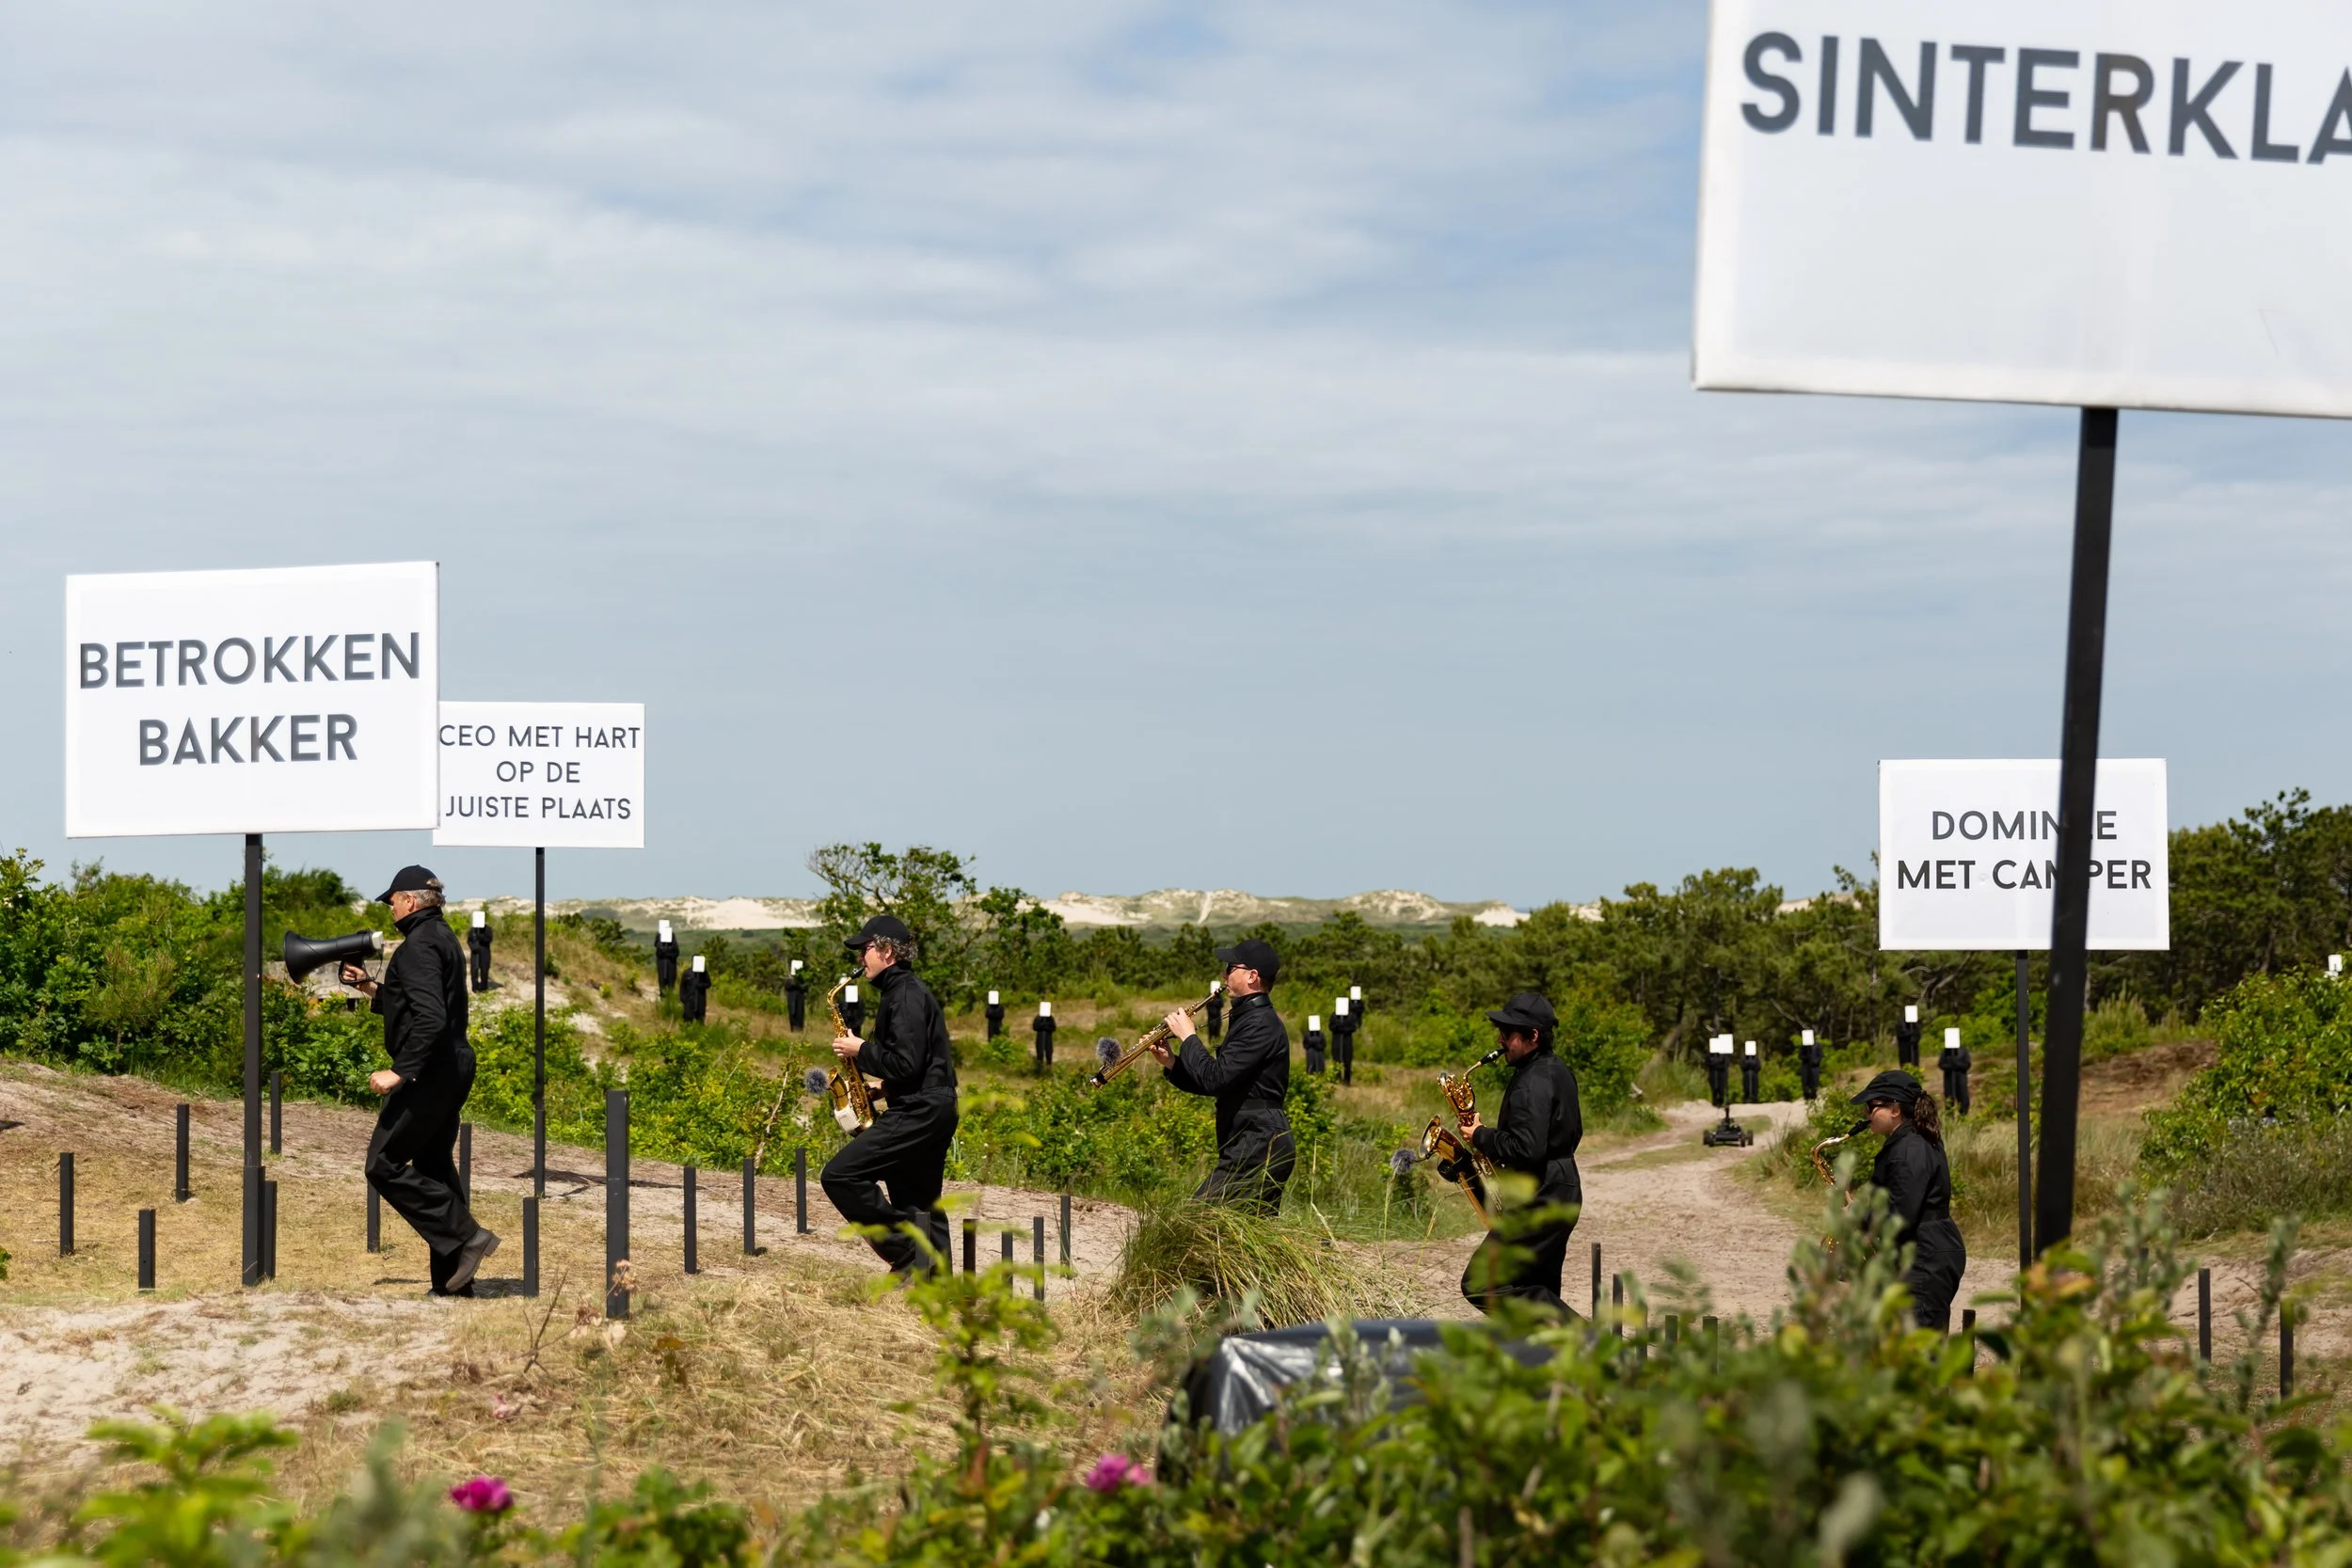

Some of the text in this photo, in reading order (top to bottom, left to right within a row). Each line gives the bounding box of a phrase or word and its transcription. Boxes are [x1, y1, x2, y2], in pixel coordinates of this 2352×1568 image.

[80, 631, 420, 689] BETROKKEN
[139, 713, 358, 766] BAKKER
[440, 724, 641, 749] CEO MET HART
[496, 760, 580, 784] OP DE
[445, 796, 631, 820] JUISTE PLAATS
[1932, 810, 2118, 841] DOMINE
[1898, 860, 1977, 890] MET
